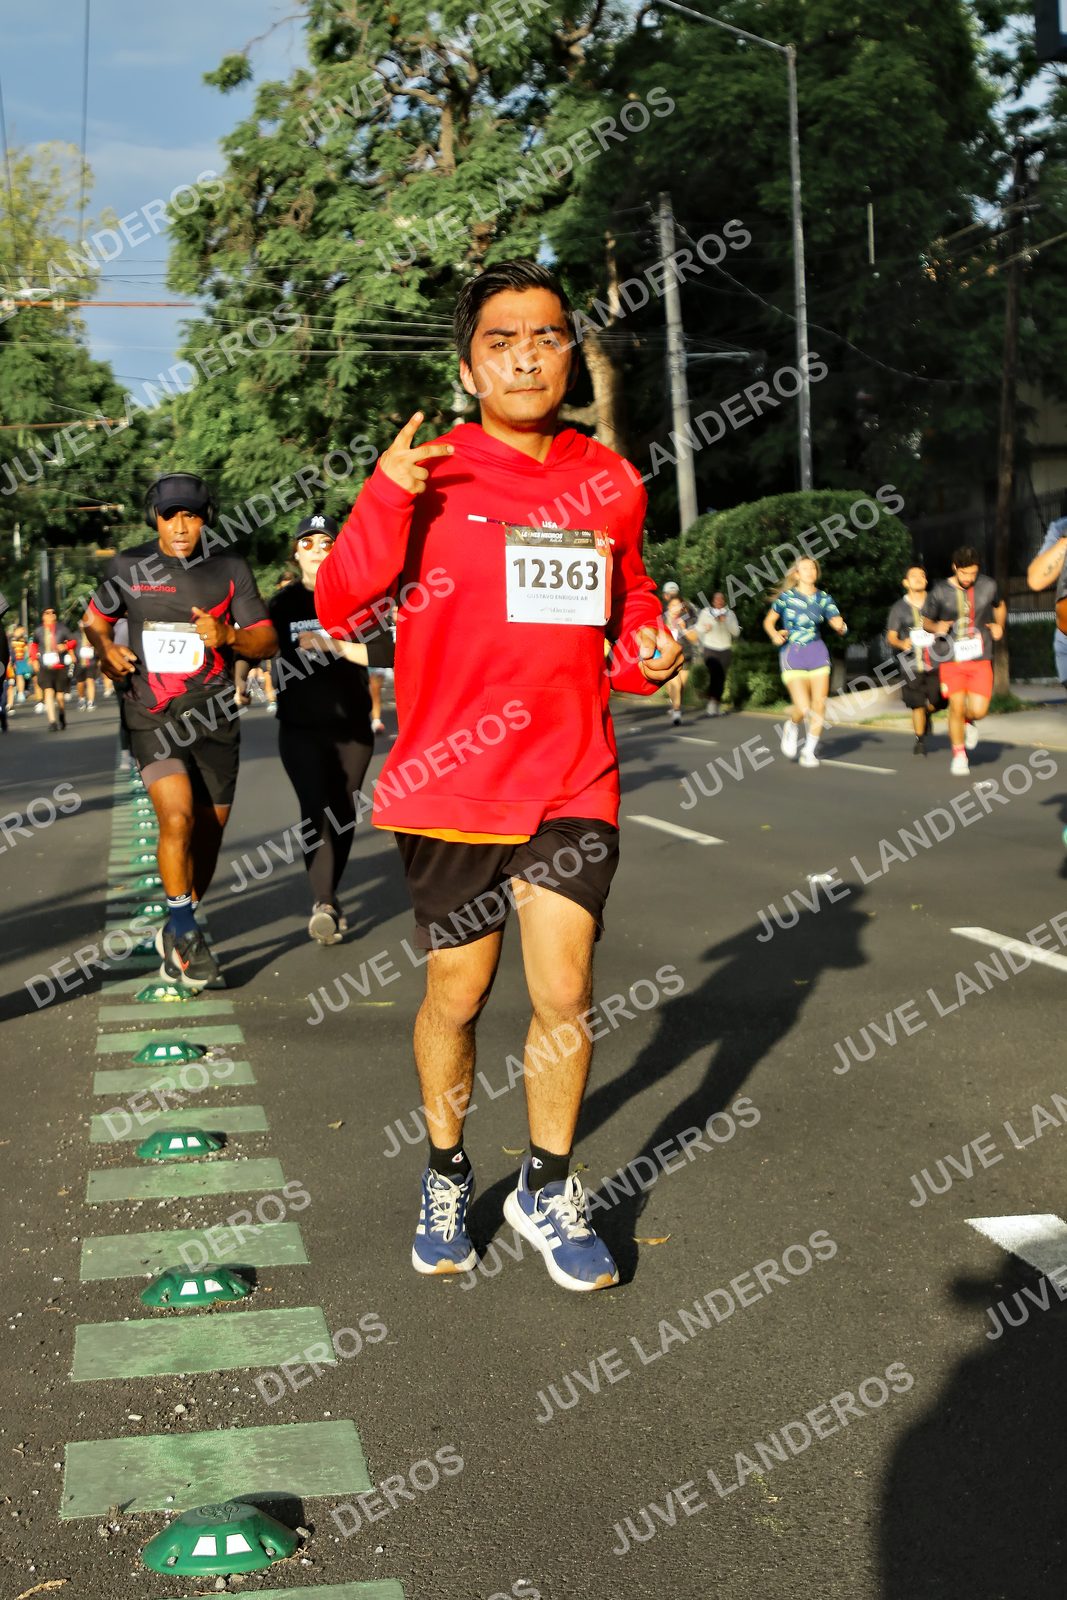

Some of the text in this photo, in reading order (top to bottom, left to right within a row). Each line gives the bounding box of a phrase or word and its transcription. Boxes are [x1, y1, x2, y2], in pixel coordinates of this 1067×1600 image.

[541, 520, 558, 529] USA
[513, 558, 599, 591] 12363
[158, 639, 187, 654] 757
